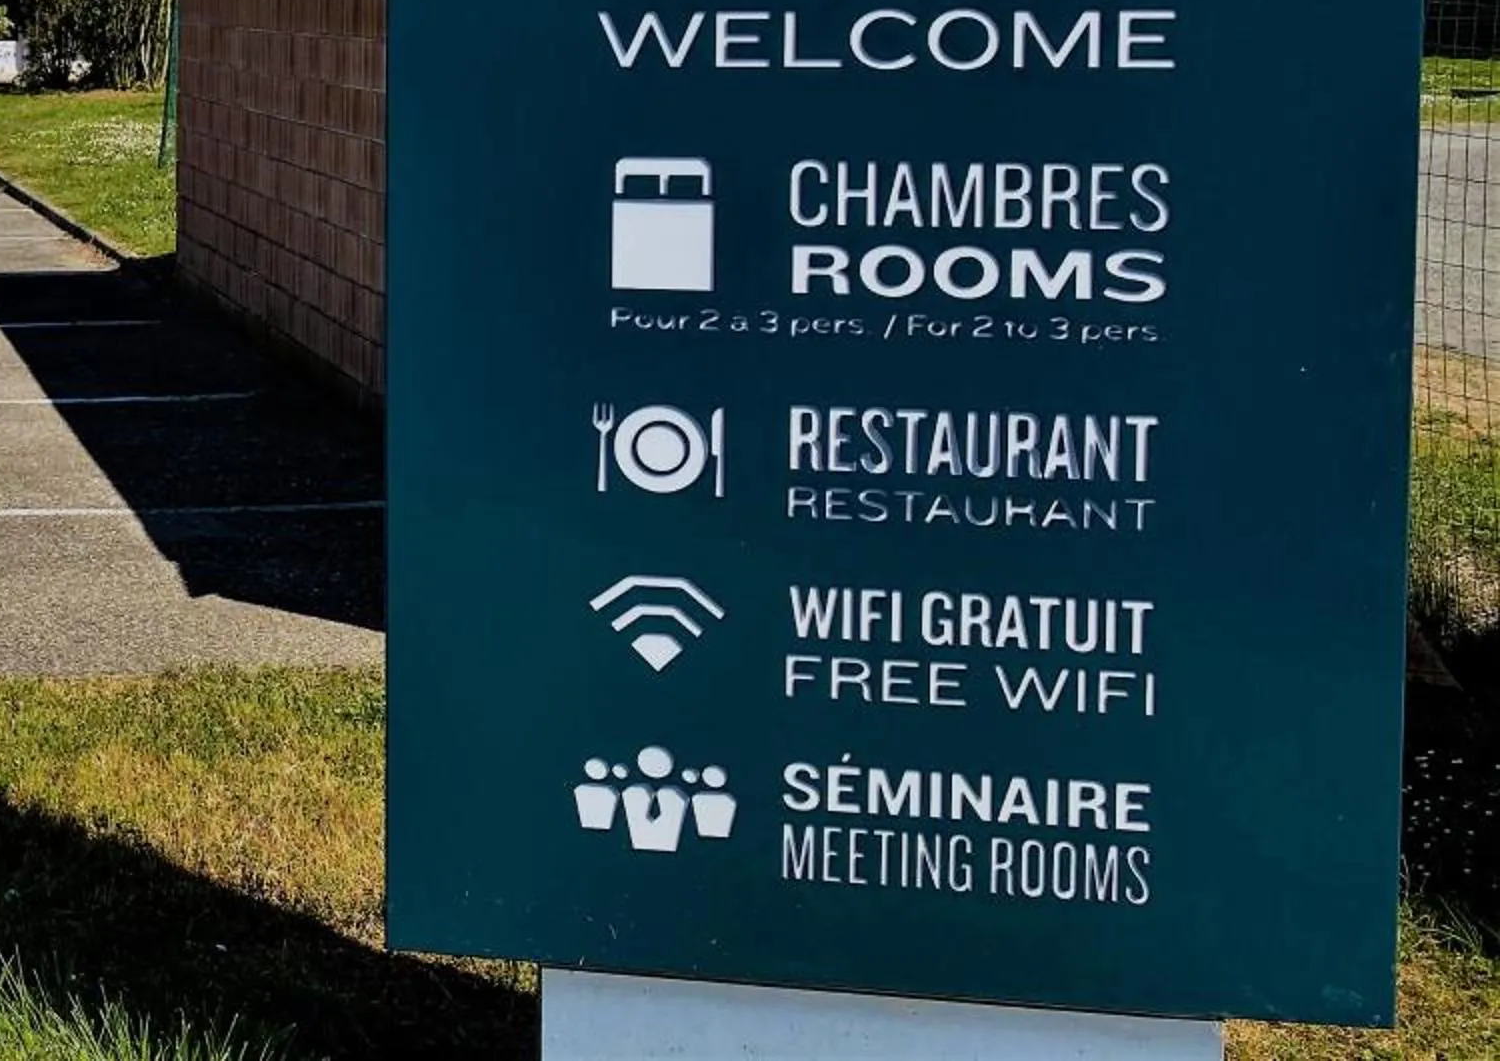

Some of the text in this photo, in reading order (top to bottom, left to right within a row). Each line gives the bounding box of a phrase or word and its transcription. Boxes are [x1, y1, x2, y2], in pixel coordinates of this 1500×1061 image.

[598, 9, 1176, 71] WELCOME
[790, 159, 1170, 232] CHAMBRES
[791, 245, 1168, 303] ROOMS
[611, 307, 690, 330] Pour
[699, 309, 720, 330] 2
[759, 310, 779, 334] 3
[883, 315, 897, 340] /
[907, 315, 962, 337] For
[972, 315, 994, 338] 2
[1004, 320, 1038, 339] to
[1049, 317, 1070, 340] 3
[789, 405, 1159, 482] RESTAURANT
[787, 487, 1156, 531] RESTAURANT
[789, 585, 1155, 654] WIFI GRATUIT
[785, 654, 1156, 716] FREE WIFI
[782, 752, 1152, 832] SÉMINAIRE
[782, 824, 1150, 905] MEETING ROOMS
